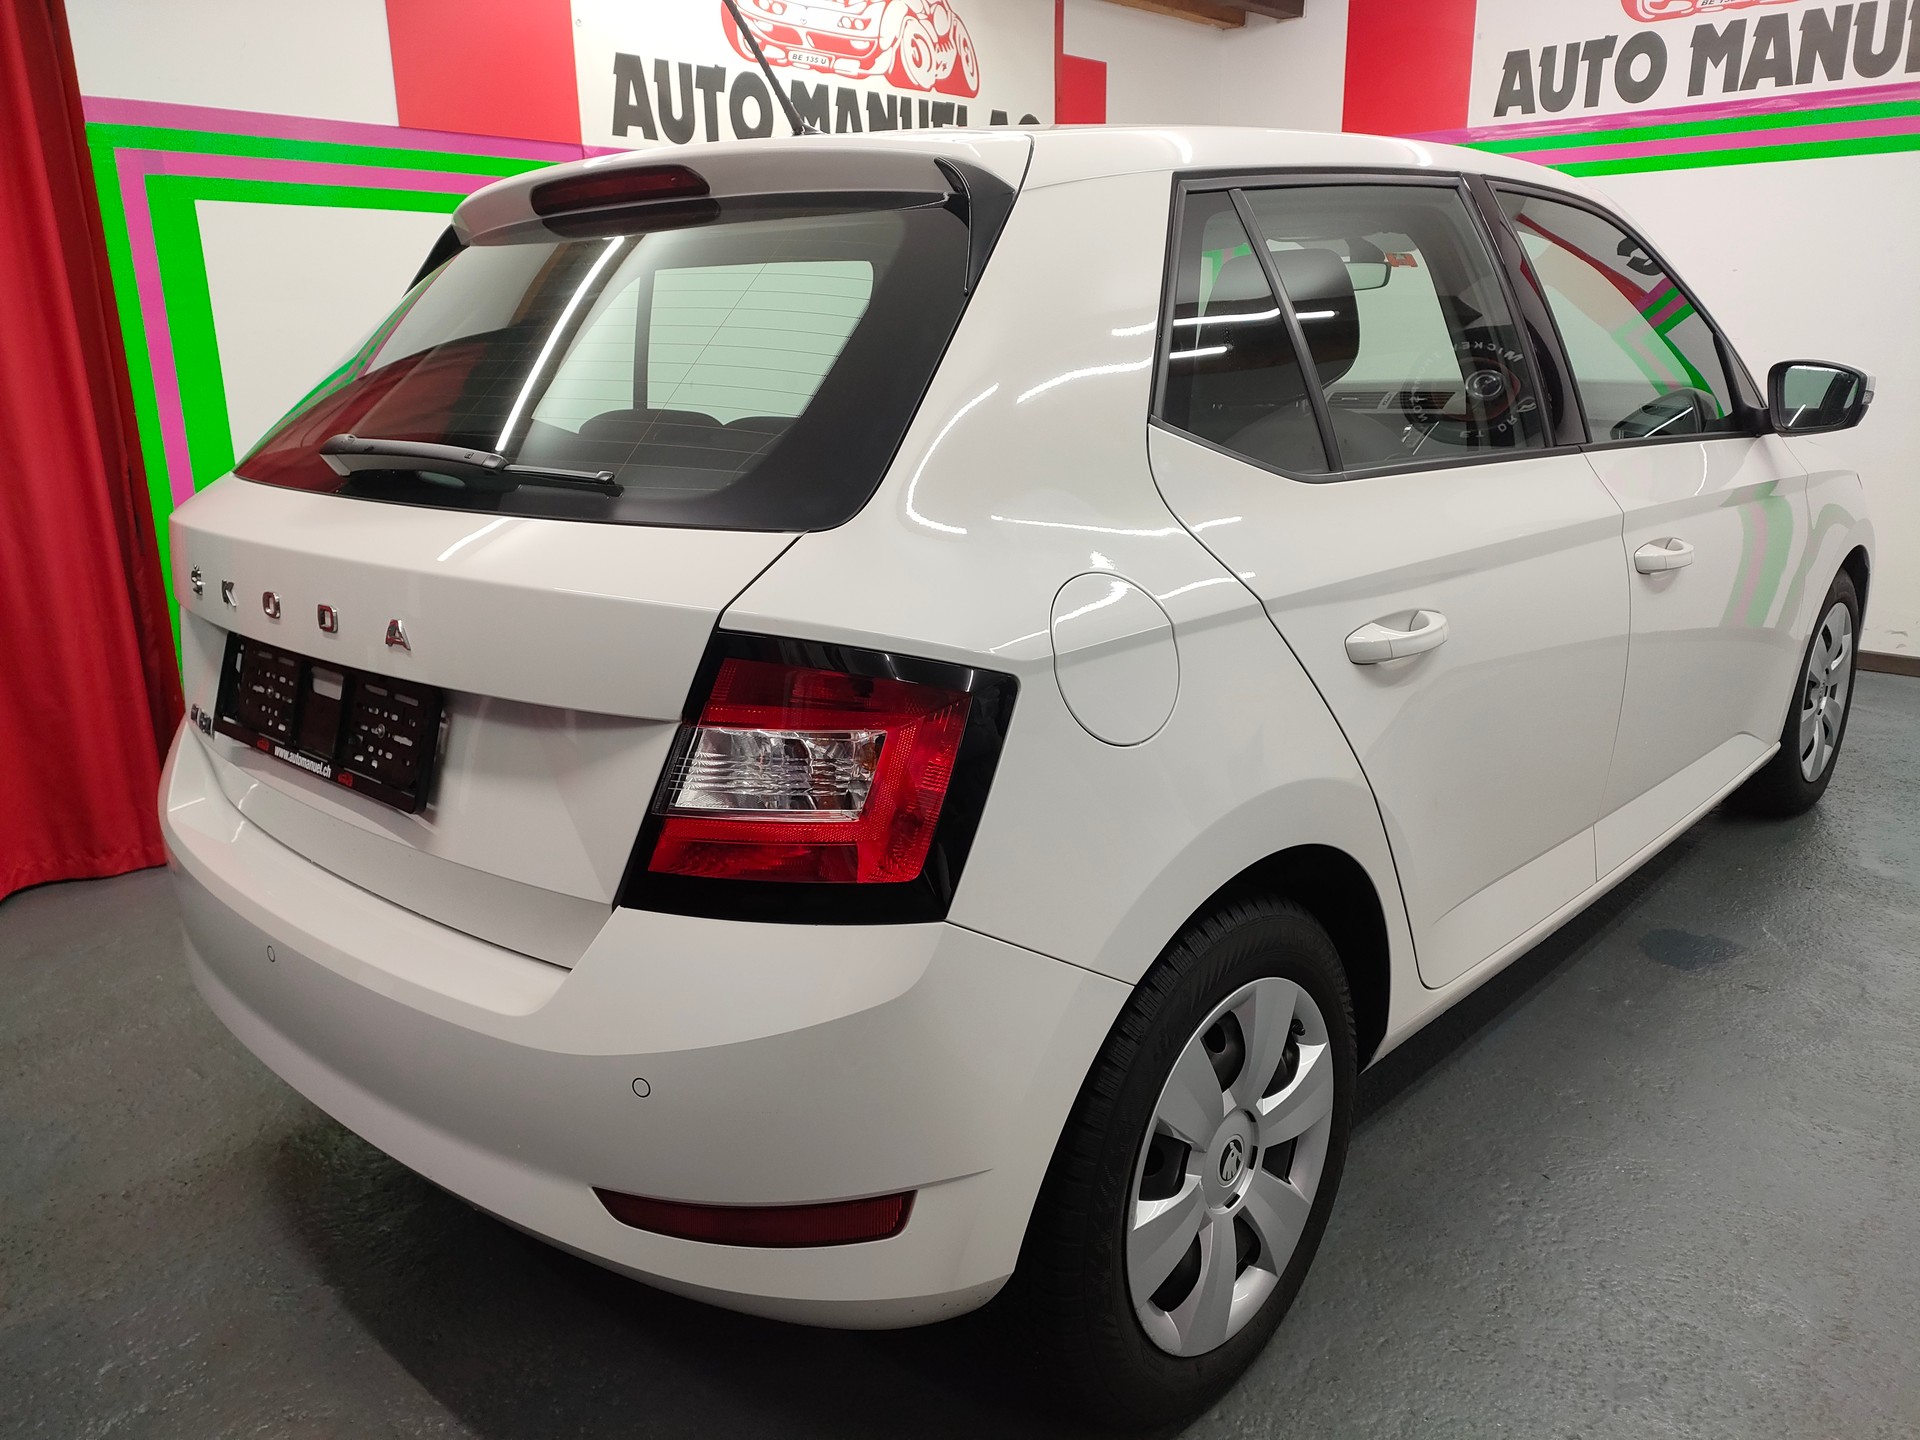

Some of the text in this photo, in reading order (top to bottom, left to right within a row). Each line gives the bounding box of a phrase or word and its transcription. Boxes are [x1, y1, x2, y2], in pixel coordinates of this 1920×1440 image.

[611, 52, 774, 145] AUTO
[1493, 30, 1667, 117] AUTO
[274, 745, 332, 779] www.automanuel.ch
